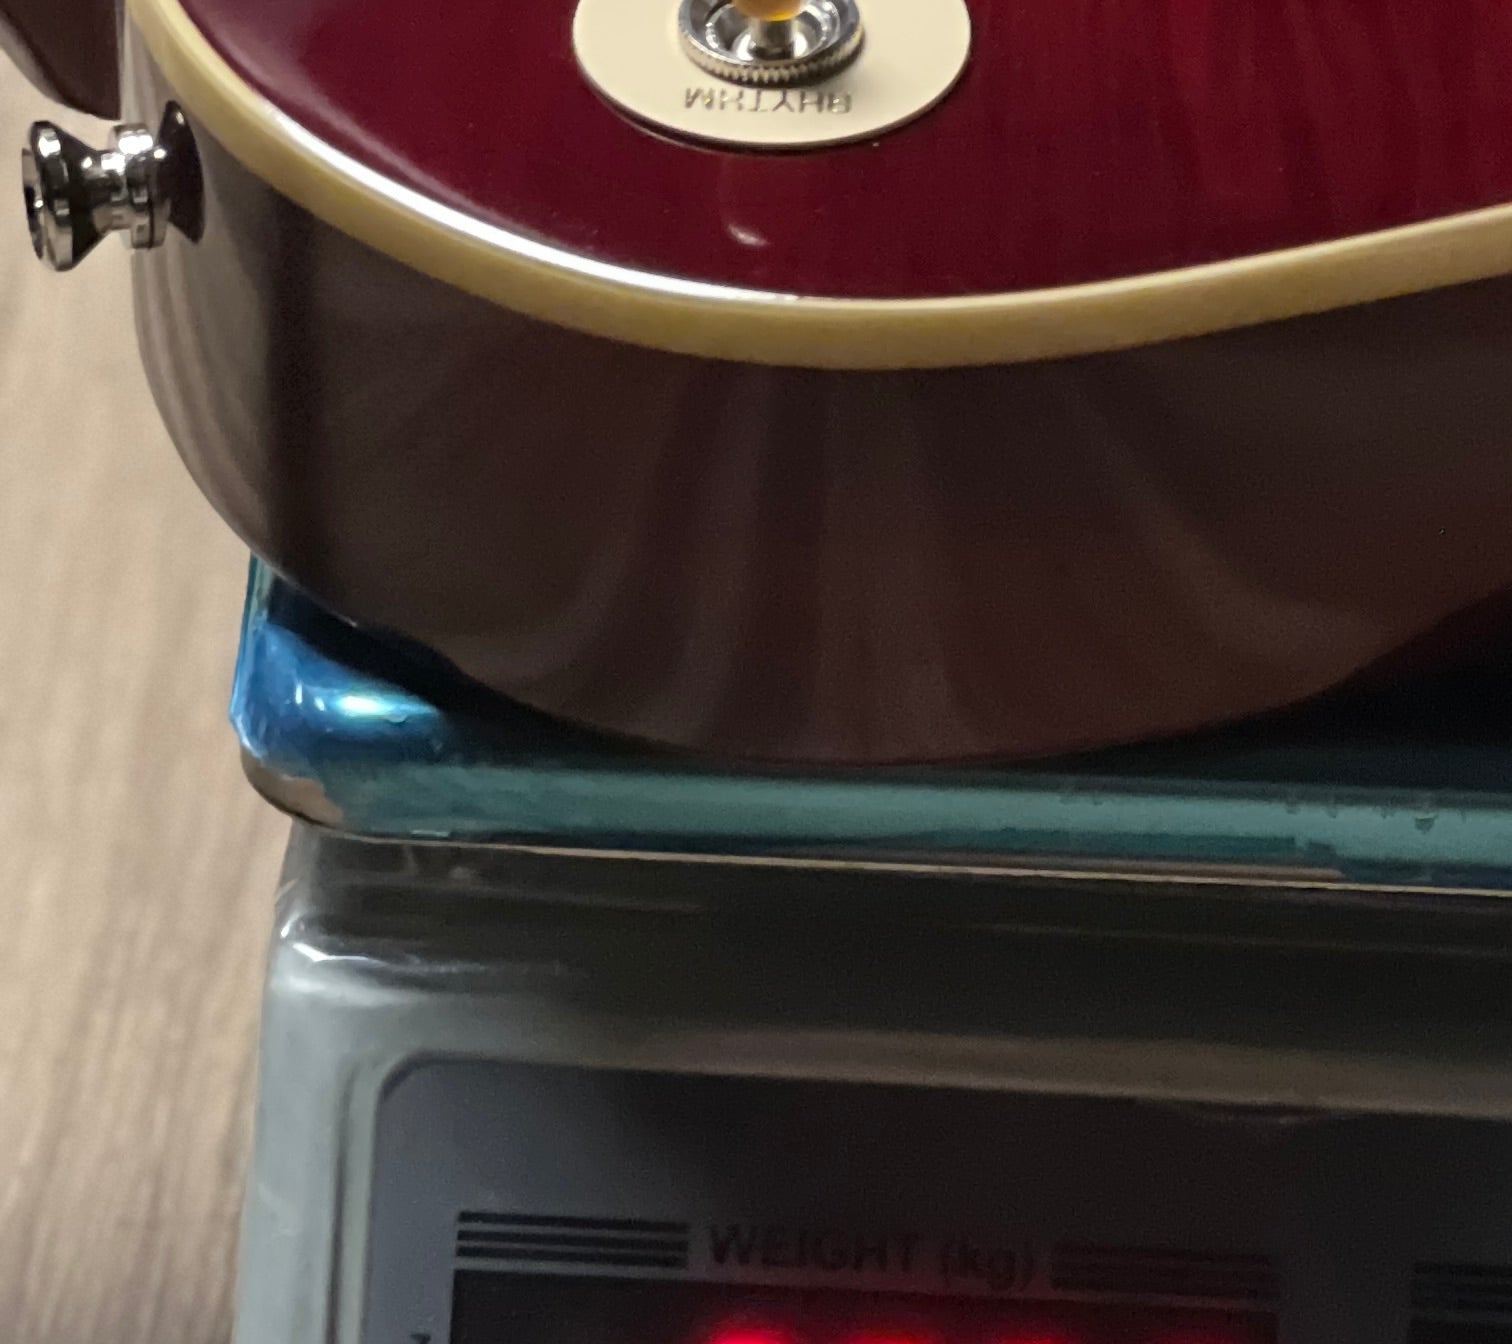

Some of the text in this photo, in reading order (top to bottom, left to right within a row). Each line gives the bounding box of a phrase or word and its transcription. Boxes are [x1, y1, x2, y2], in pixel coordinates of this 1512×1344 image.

[685, 87, 853, 114] RHYTHM
[708, 1223, 1034, 1291] WEIGHT (kg)
